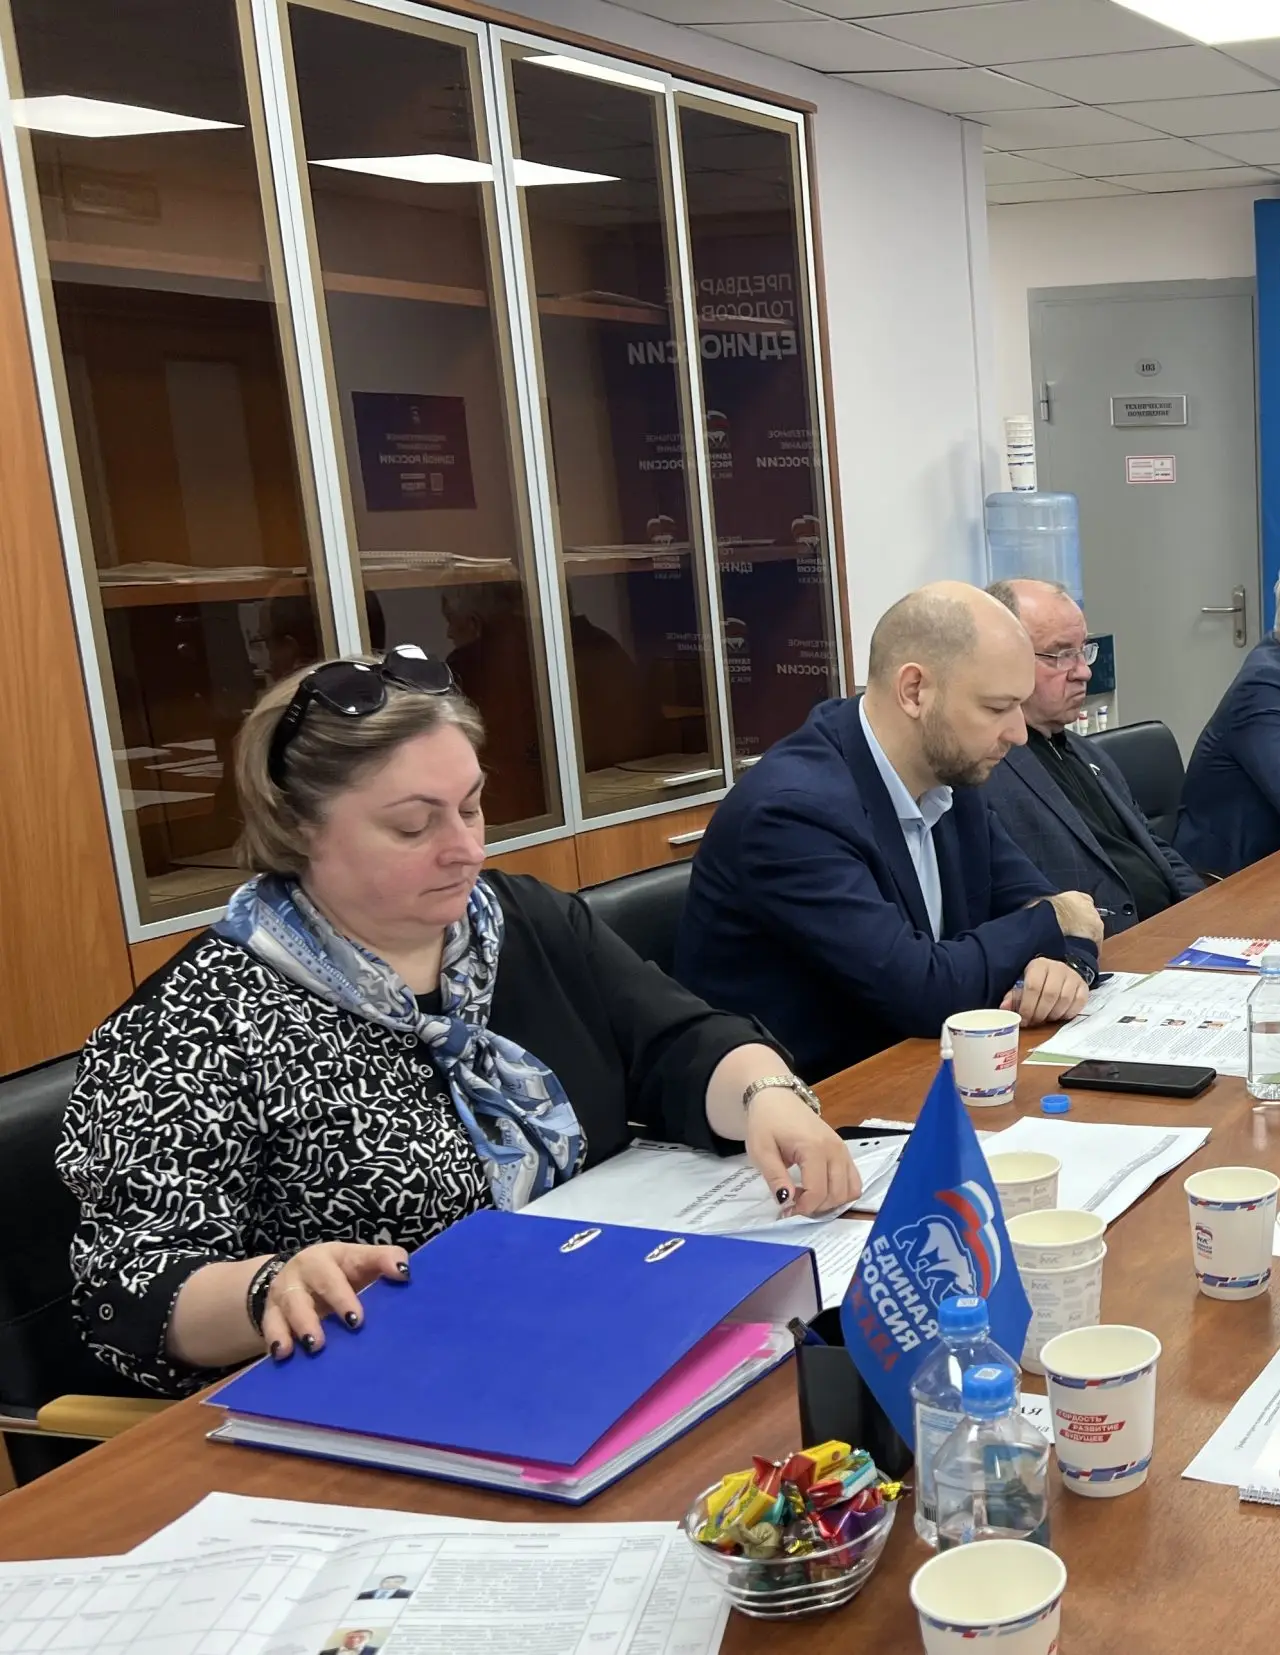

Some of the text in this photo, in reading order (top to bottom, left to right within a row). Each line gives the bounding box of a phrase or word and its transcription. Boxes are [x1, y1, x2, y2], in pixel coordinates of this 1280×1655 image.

[873, 1235, 939, 1340] ЕДИНАЯ
[862, 1246, 921, 1352] РОССИЯ
[1058, 1410, 1102, 1423] ГОРДОСТЬ
[1073, 1422, 1119, 1432] РАЗВИТИЕ
[1065, 1431, 1104, 1442] БУДУЩЕЕ
